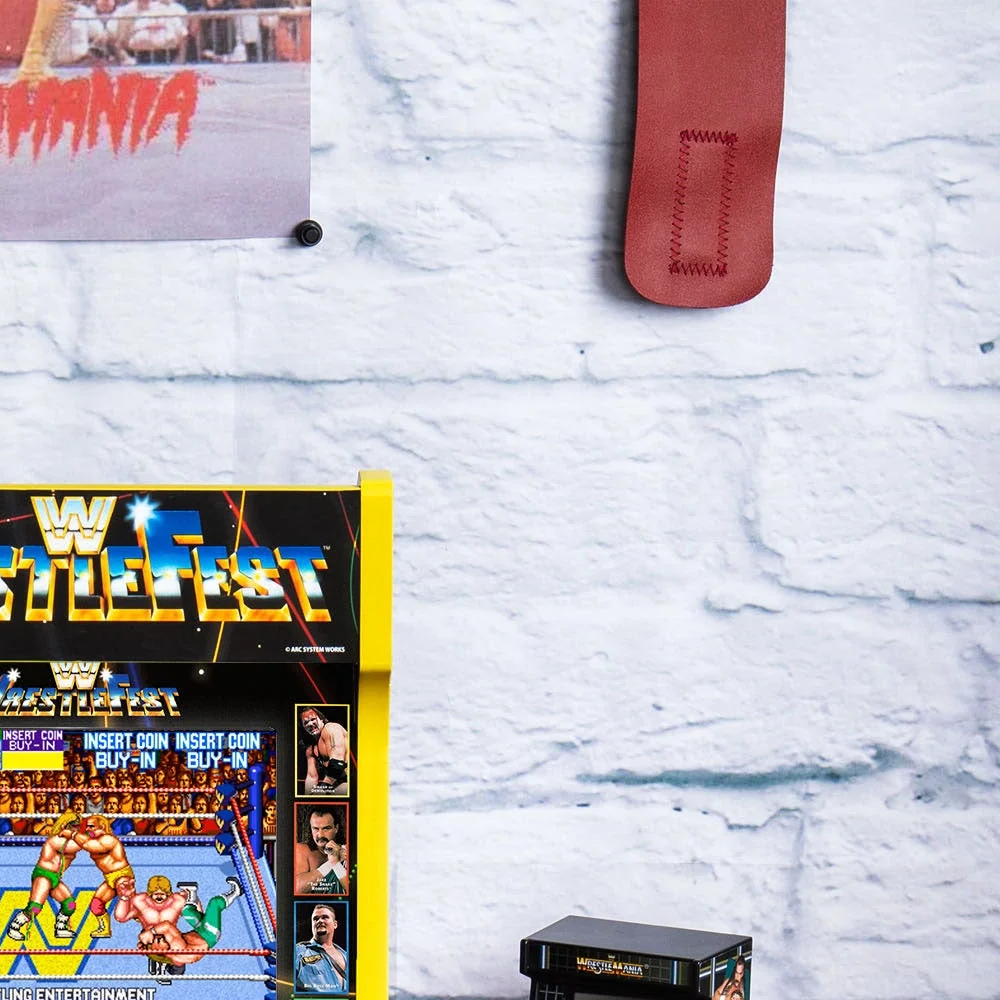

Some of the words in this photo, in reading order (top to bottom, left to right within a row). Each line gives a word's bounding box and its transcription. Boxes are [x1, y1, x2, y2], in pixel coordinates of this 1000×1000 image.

[2, 730, 37, 740] INSERT
[42, 730, 63, 740] COIN
[84, 732, 133, 750] INSERT
[136, 732, 169, 750] COIN
[175, 732, 225, 750] INSERT
[227, 732, 261, 750] COIN
[9, 741, 56, 750] BUY-IN
[95, 751, 157, 769] BUY-IN
[186, 751, 248, 769] BUY-IN
[36, 987, 157, 1000] ENTERTAINMENT
